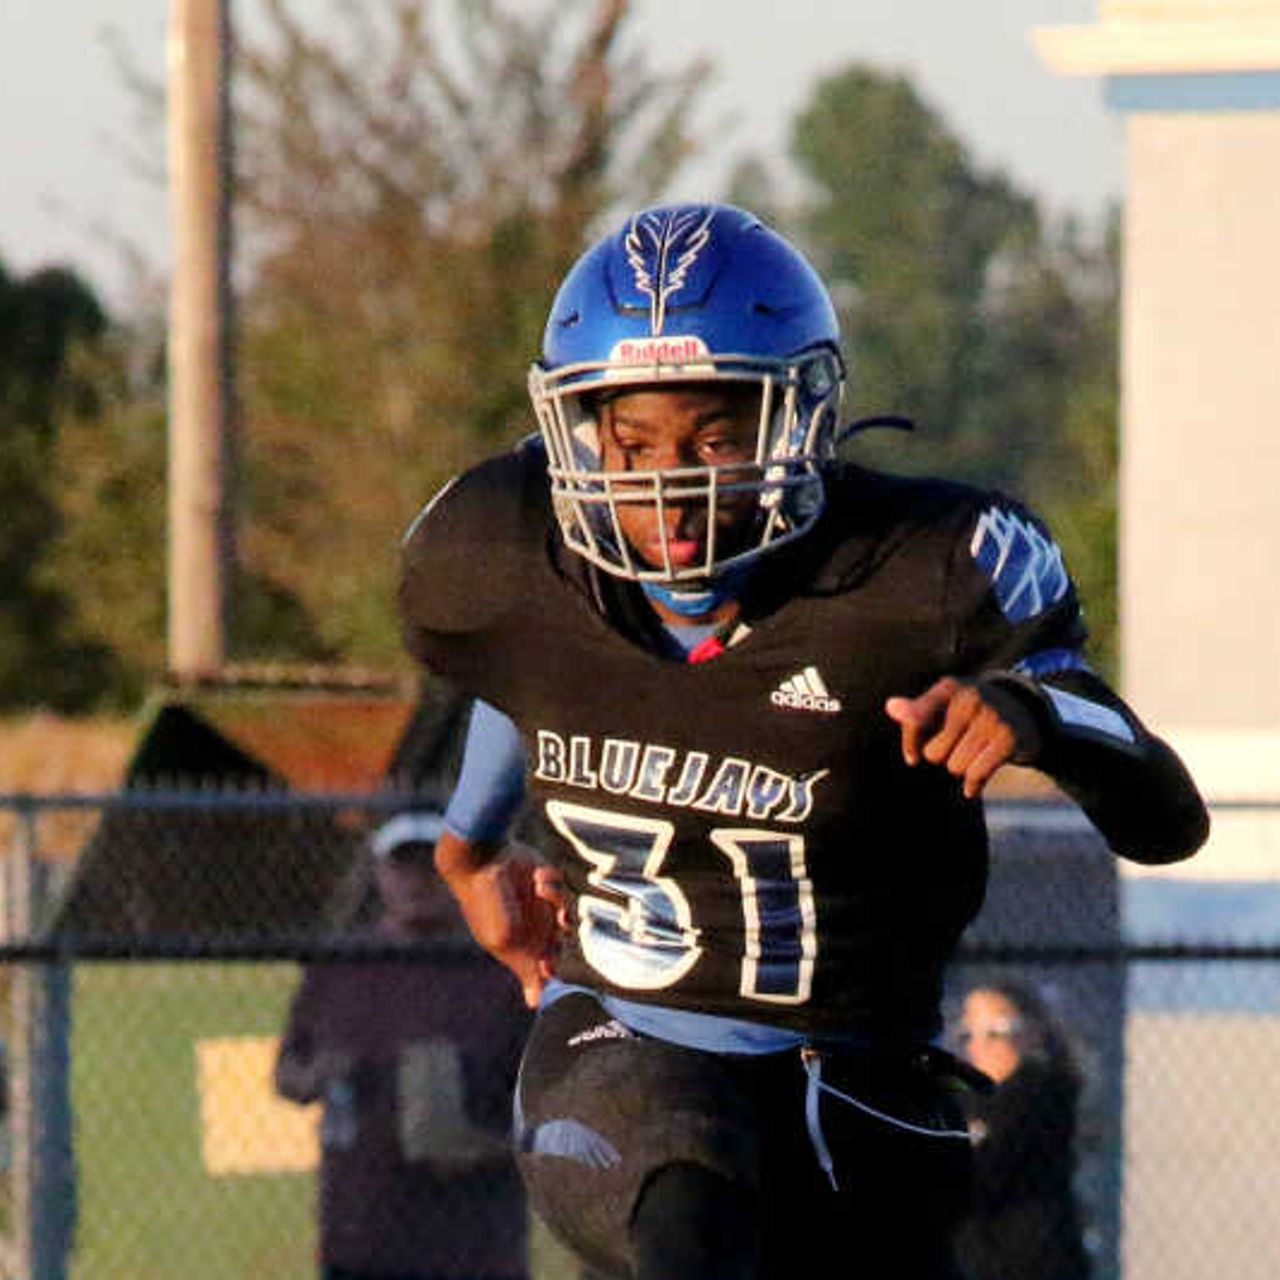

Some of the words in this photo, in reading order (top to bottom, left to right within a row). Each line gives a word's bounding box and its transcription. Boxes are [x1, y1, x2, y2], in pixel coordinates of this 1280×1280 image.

[770, 690, 842, 712] adidas
[534, 729, 831, 823] BLUEJAYS
[545, 799, 819, 1005] 31
